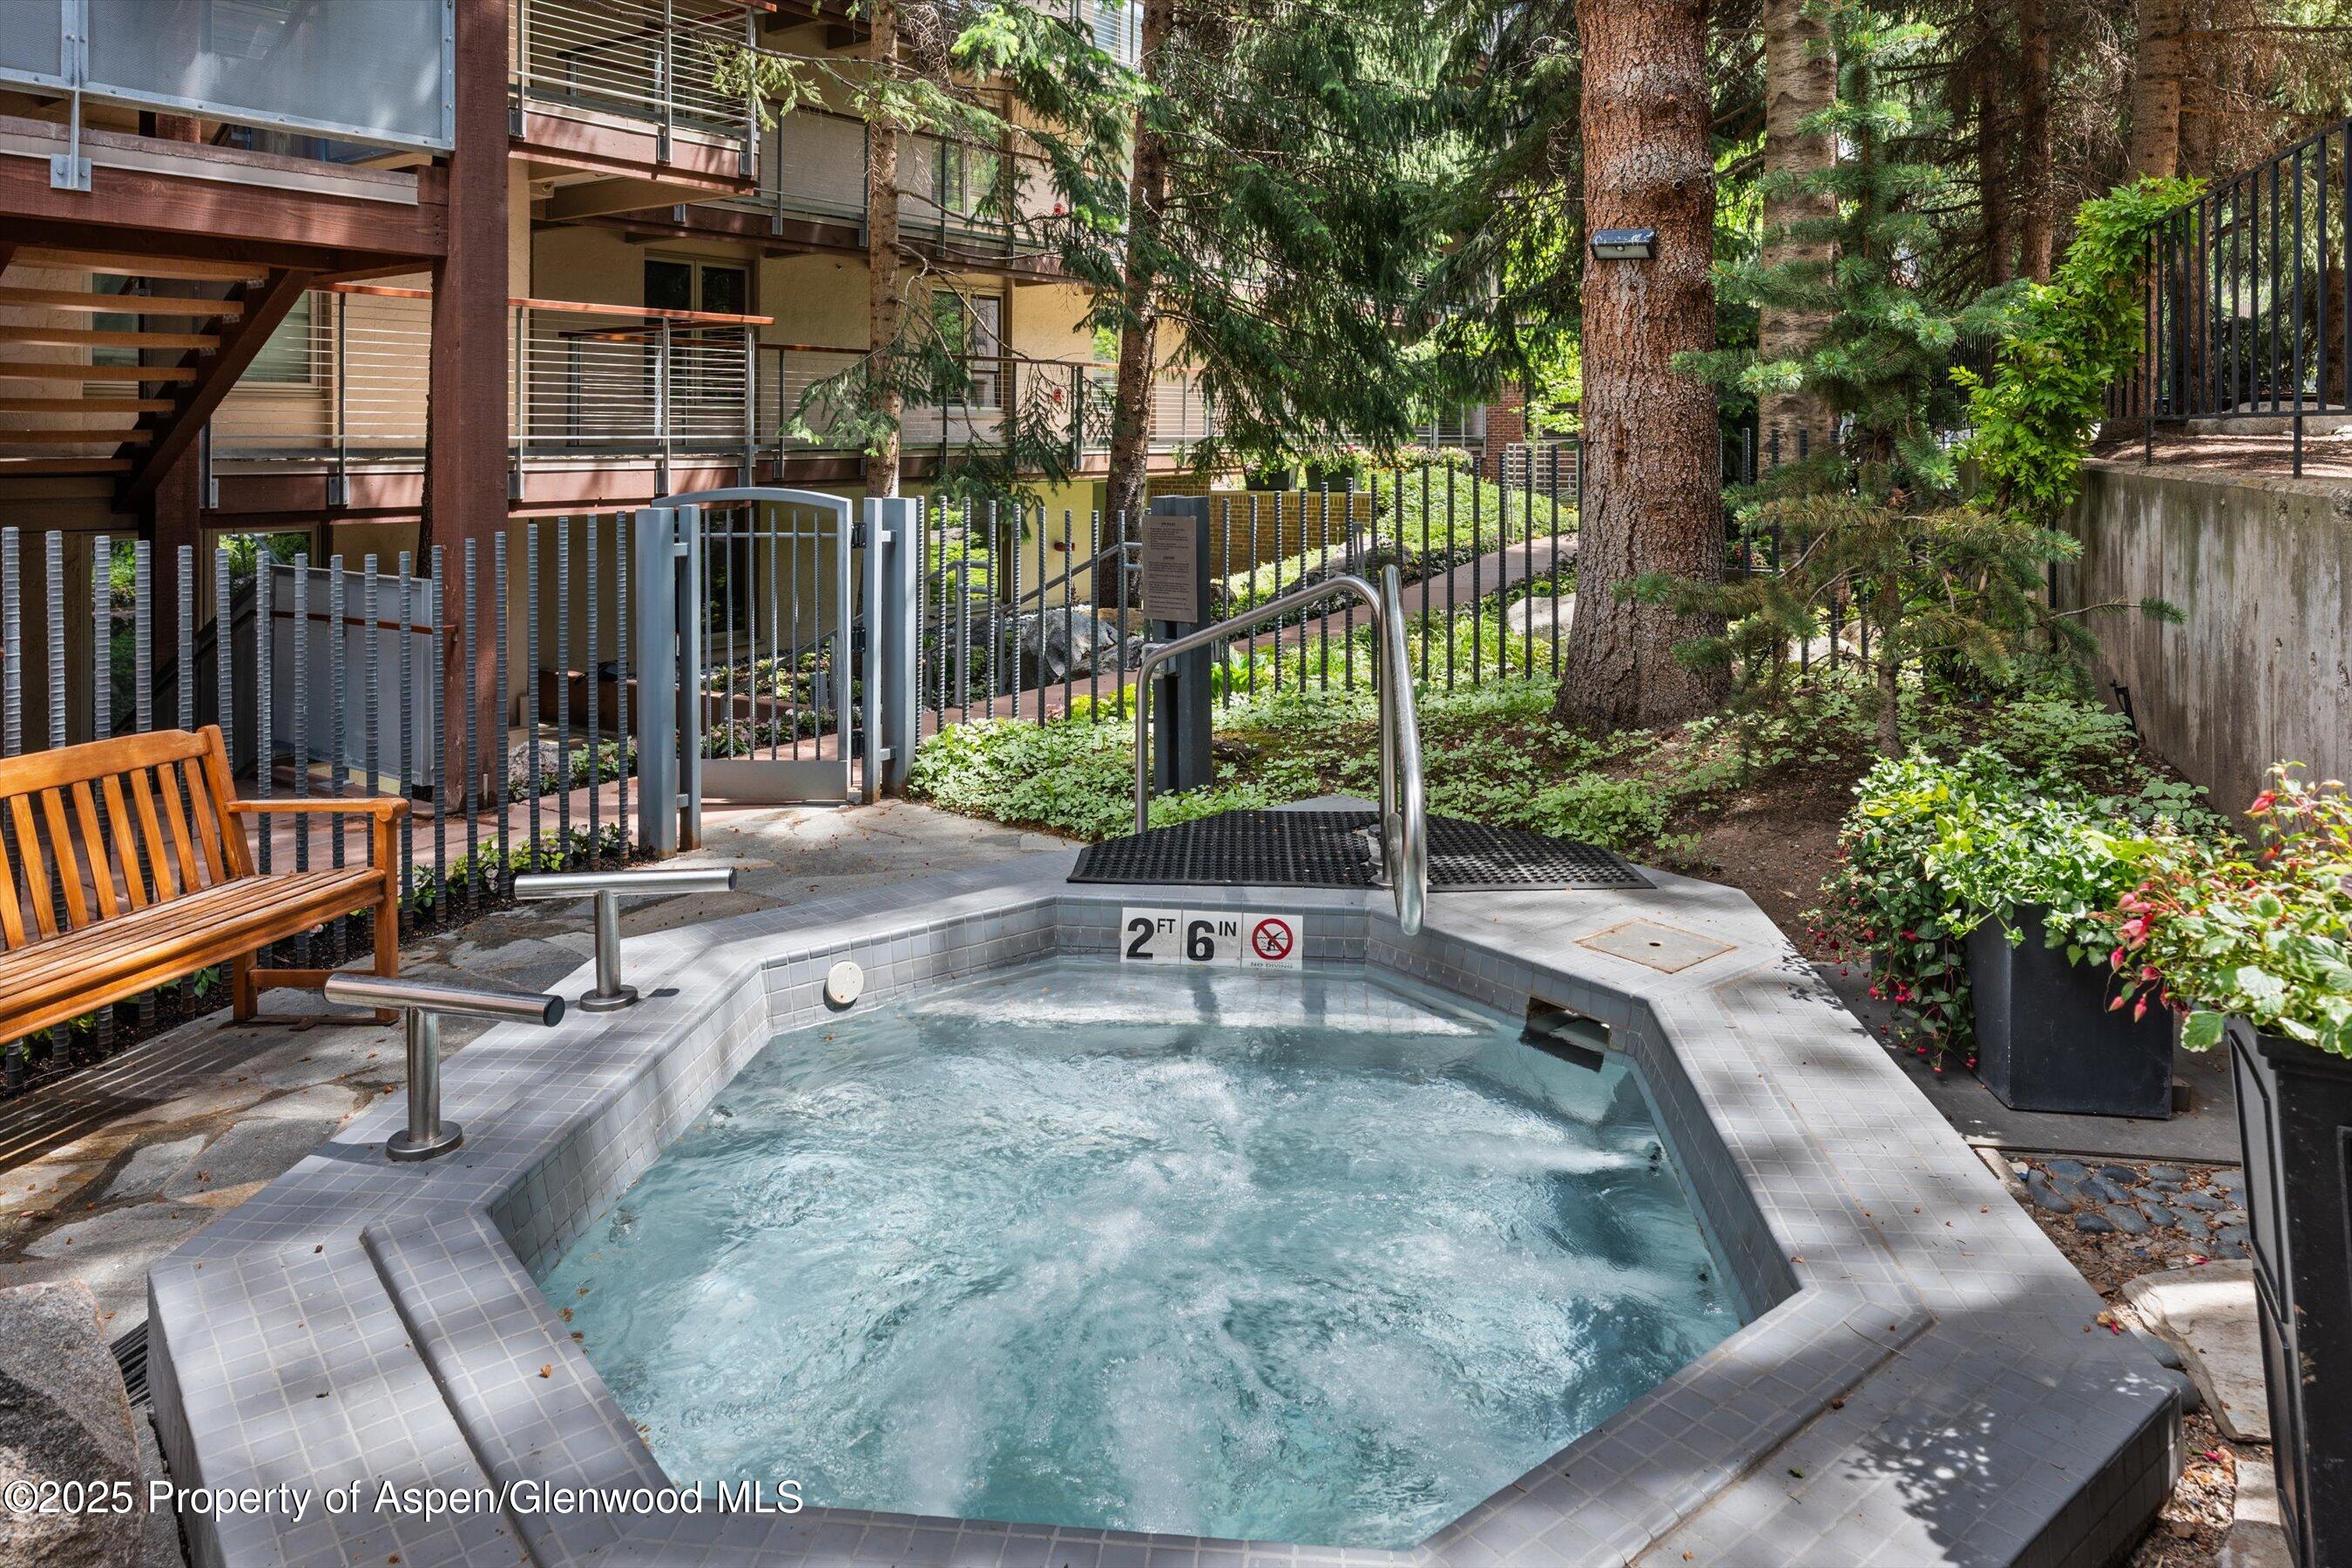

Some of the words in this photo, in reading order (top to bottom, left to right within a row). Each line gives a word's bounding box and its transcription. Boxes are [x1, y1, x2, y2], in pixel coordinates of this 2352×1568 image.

[1126, 917, 1154, 960] 2
[1157, 918, 1176, 934] FT
[1187, 920, 1215, 962] 6
[1219, 921, 1237, 936] IN
